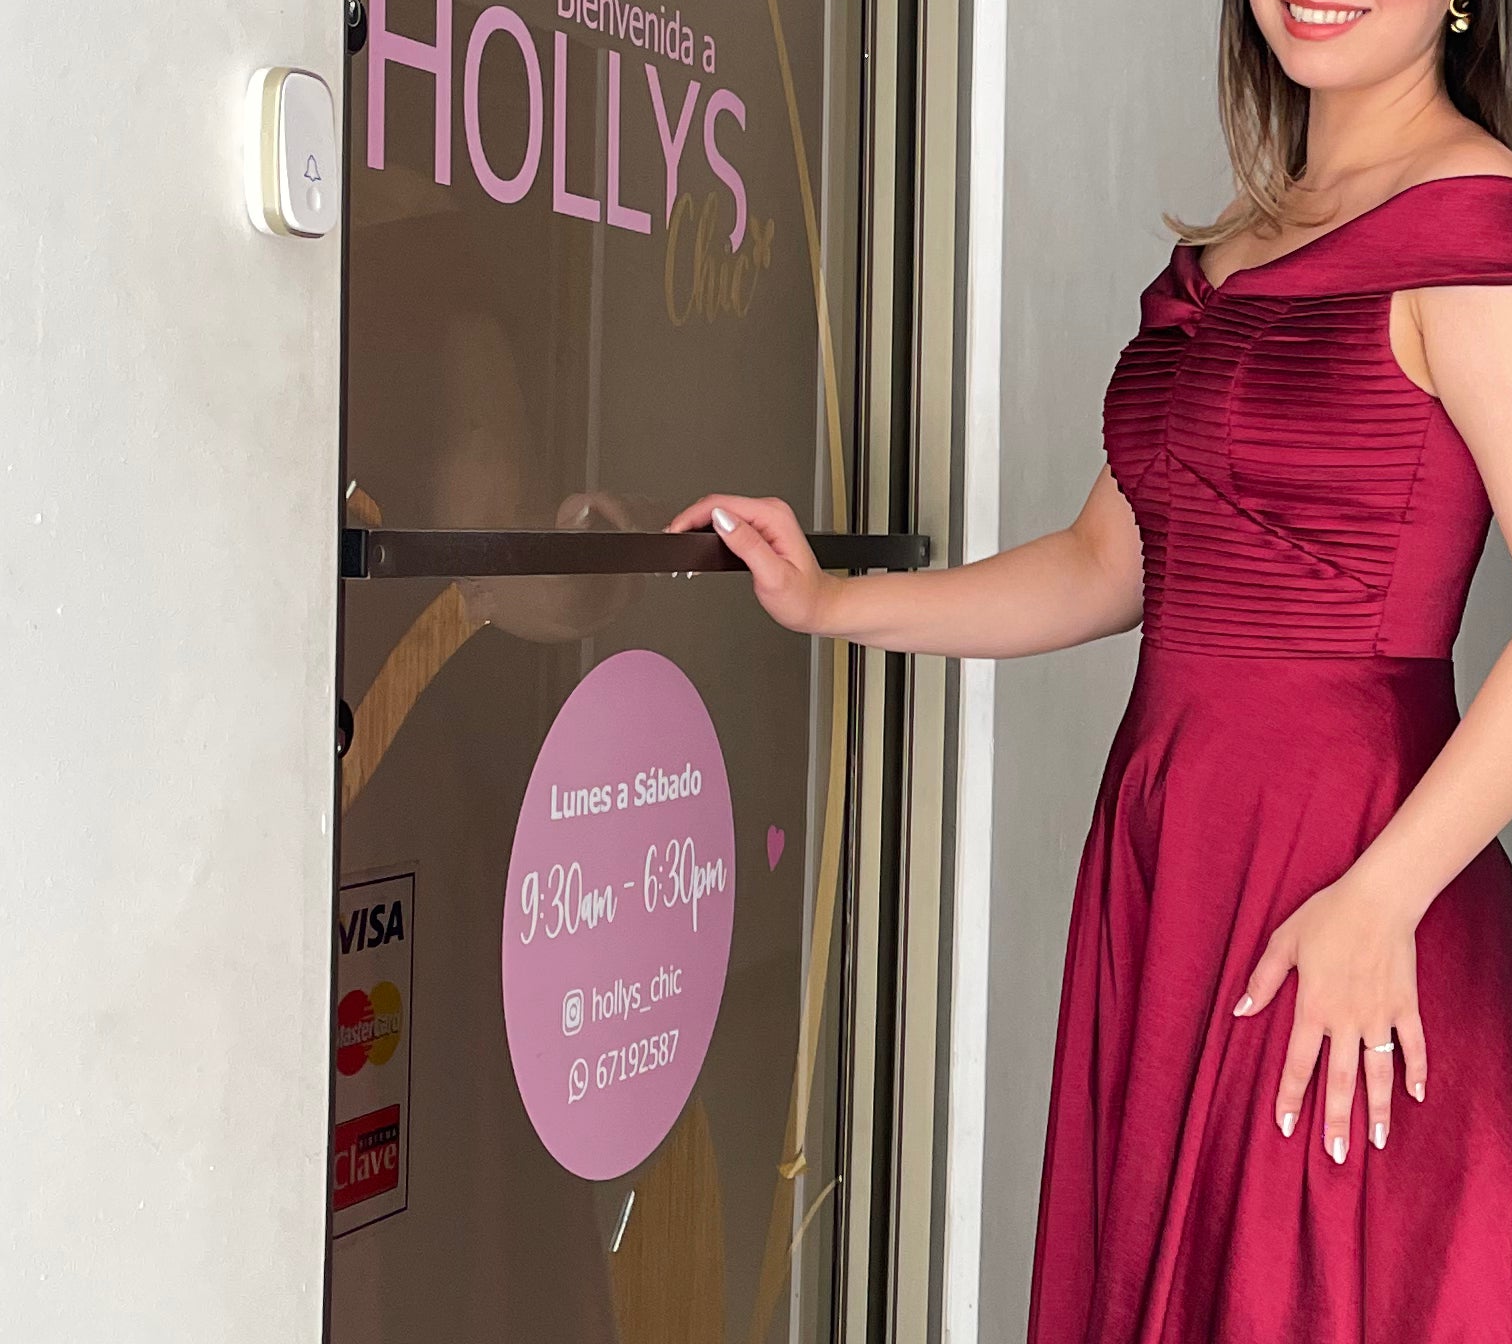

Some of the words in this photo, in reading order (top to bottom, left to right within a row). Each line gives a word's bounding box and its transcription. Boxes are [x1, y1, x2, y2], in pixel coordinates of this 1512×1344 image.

[702, 35, 716, 74] a
[664, 191, 758, 327] Chic
[550, 784, 612, 820] Lunes
[616, 782, 629, 810] a
[633, 762, 702, 807] Sábado
[520, 861, 618, 945] 9:30am
[643, 836, 727, 933] 6:30pm
[338, 900, 404, 955] VISA
[591, 964, 682, 1022] hollys_chic
[596, 1028, 679, 1089] 67192587
[334, 1143, 397, 1190] Clave
